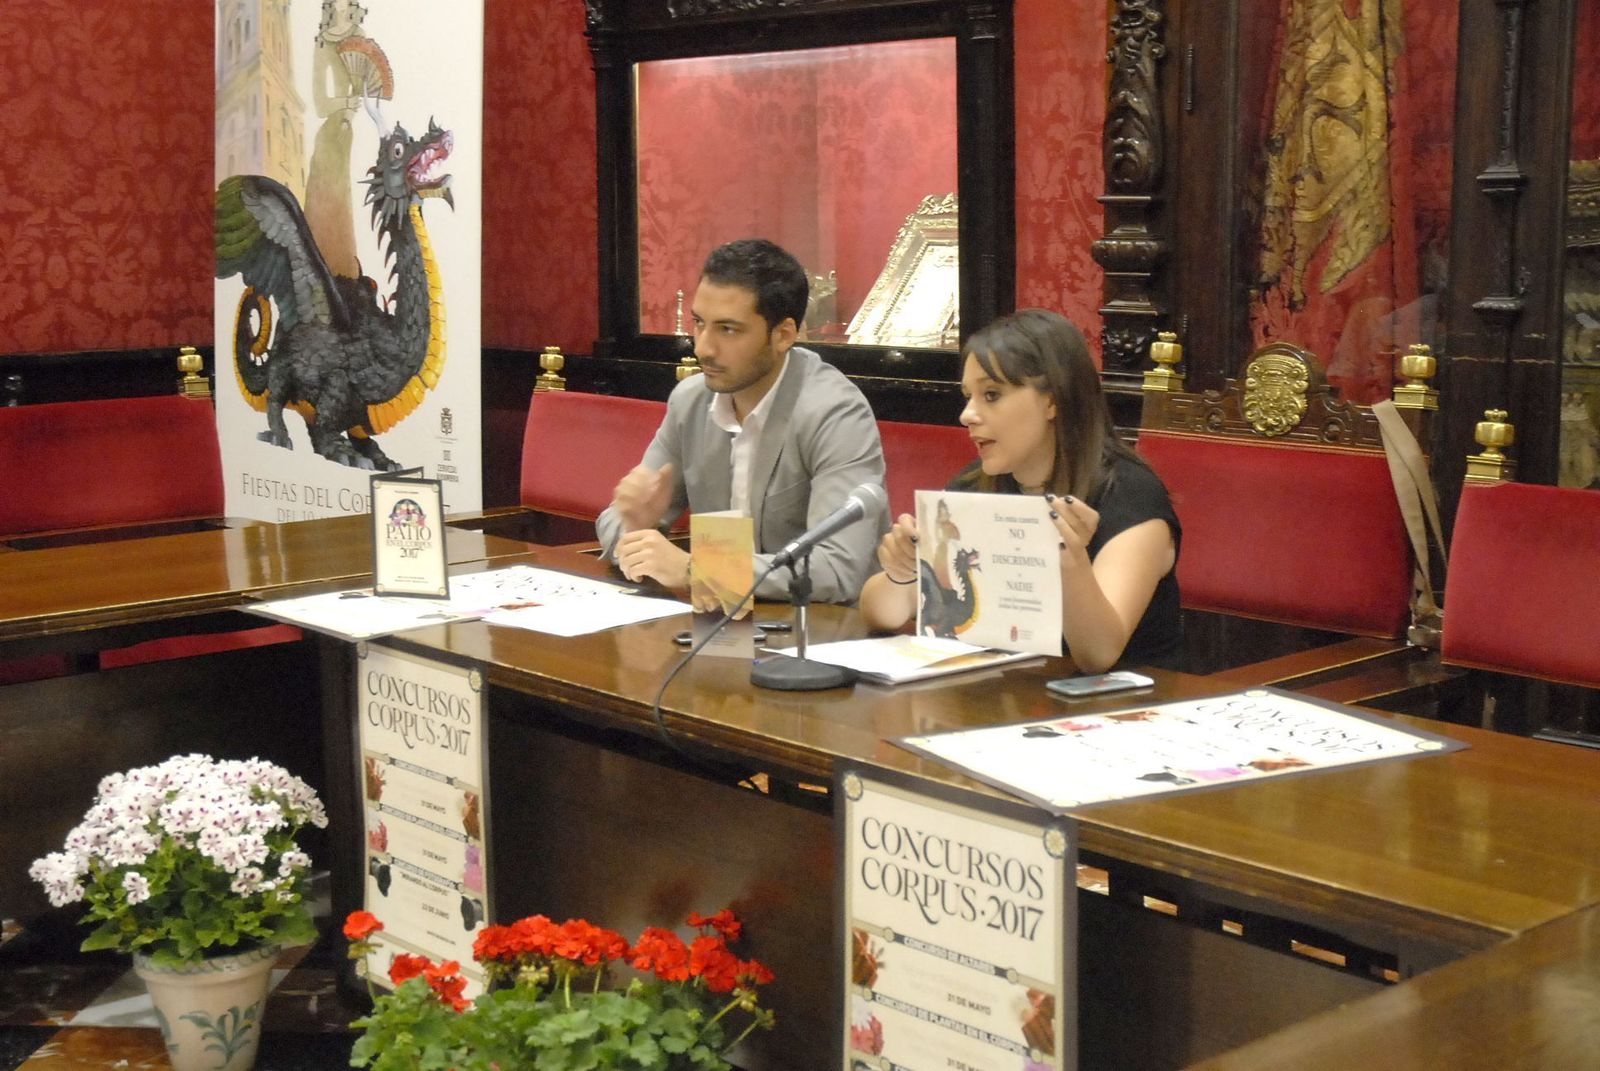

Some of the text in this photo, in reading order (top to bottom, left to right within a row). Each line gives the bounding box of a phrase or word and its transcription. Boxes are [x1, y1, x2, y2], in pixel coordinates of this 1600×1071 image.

[242, 473, 297, 502] FIESTAS
[304, 485, 332, 508] DEL
[386, 523, 432, 541] PATIO
[1009, 528, 1025, 540] NO
[400, 547, 424, 558] 2017
[992, 554, 1047, 568] DISCRIMINA
[1006, 580, 1034, 593] NADIE
[367, 670, 471, 725] CONCURSOS
[861, 817, 1044, 901] CONCURSOS
[957, 996, 967, 1006] DE
[968, 999, 991, 1015] MAYO
